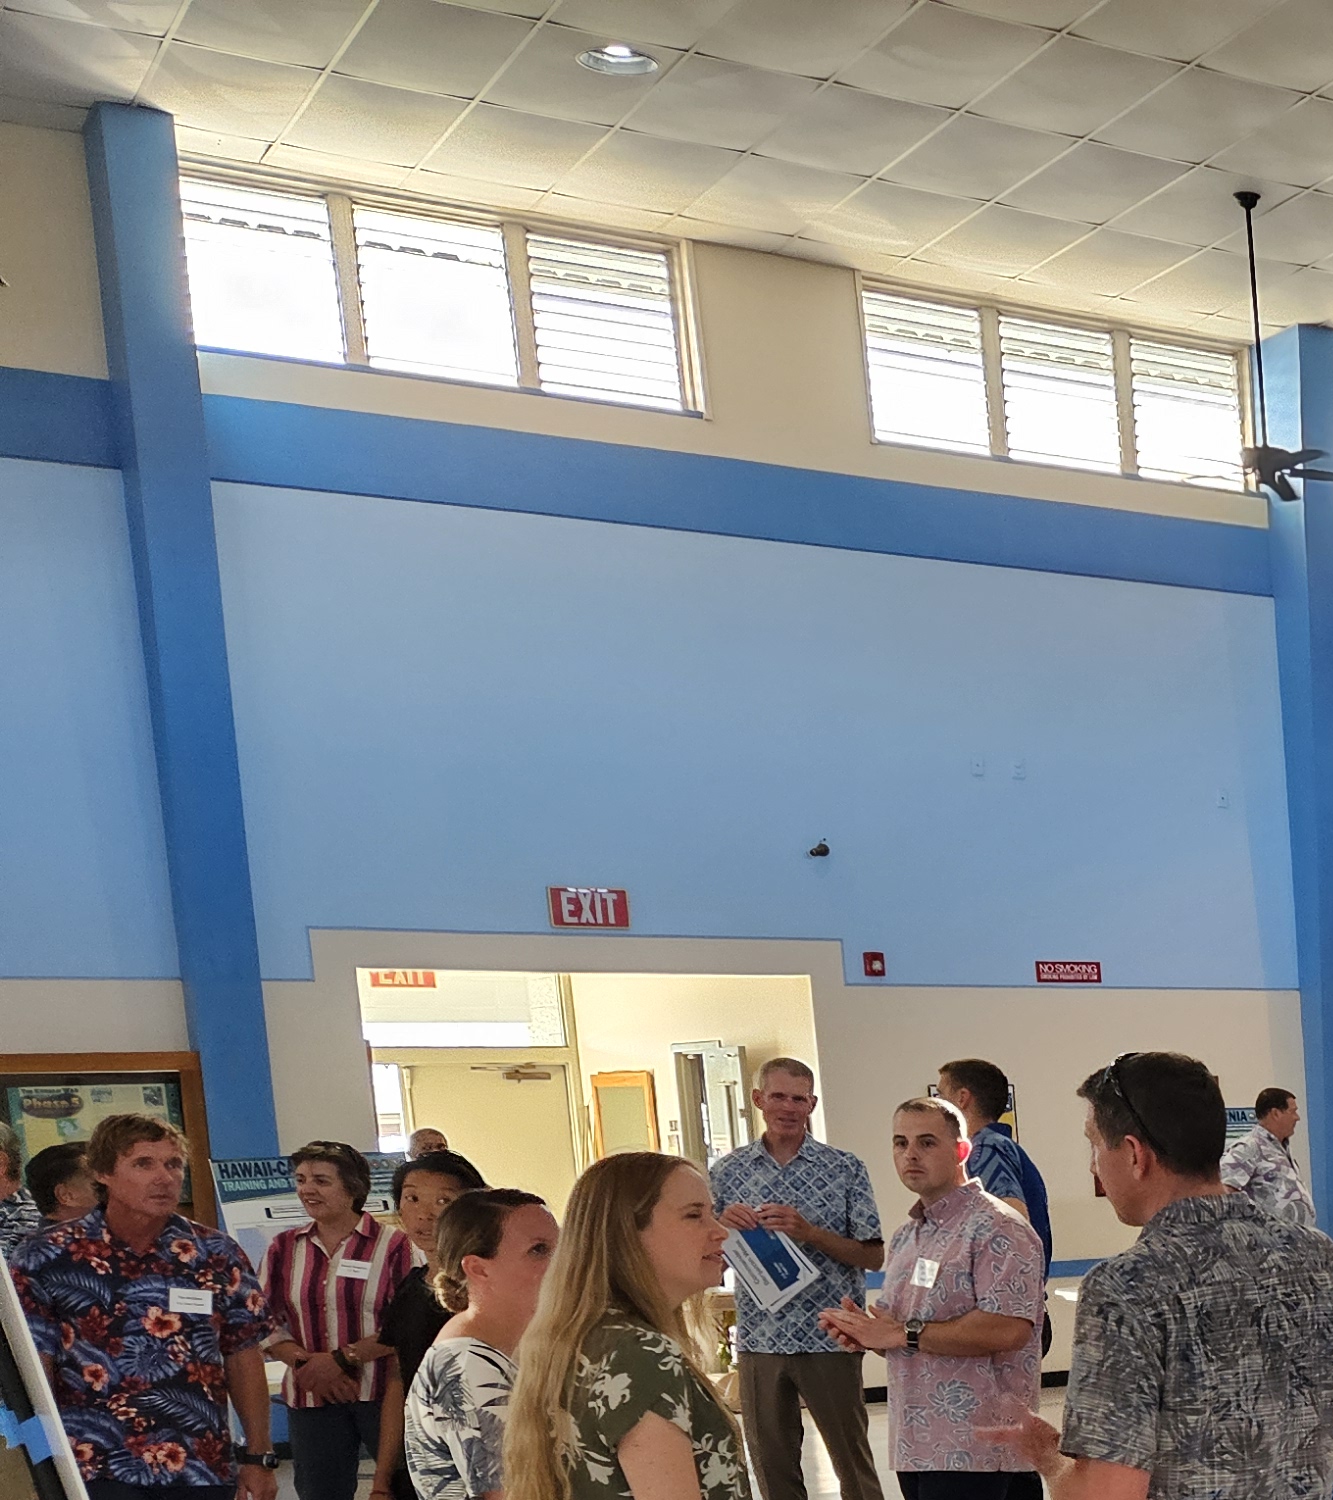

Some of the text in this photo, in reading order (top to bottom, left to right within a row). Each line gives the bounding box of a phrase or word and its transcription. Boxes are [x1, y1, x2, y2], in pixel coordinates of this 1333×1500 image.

[560, 890, 618, 925] EXIT
[1039, 963, 1098, 974] NO SMOKING
[222, 1179, 267, 1192] TRAINING
[268, 1177, 290, 1190] AND
